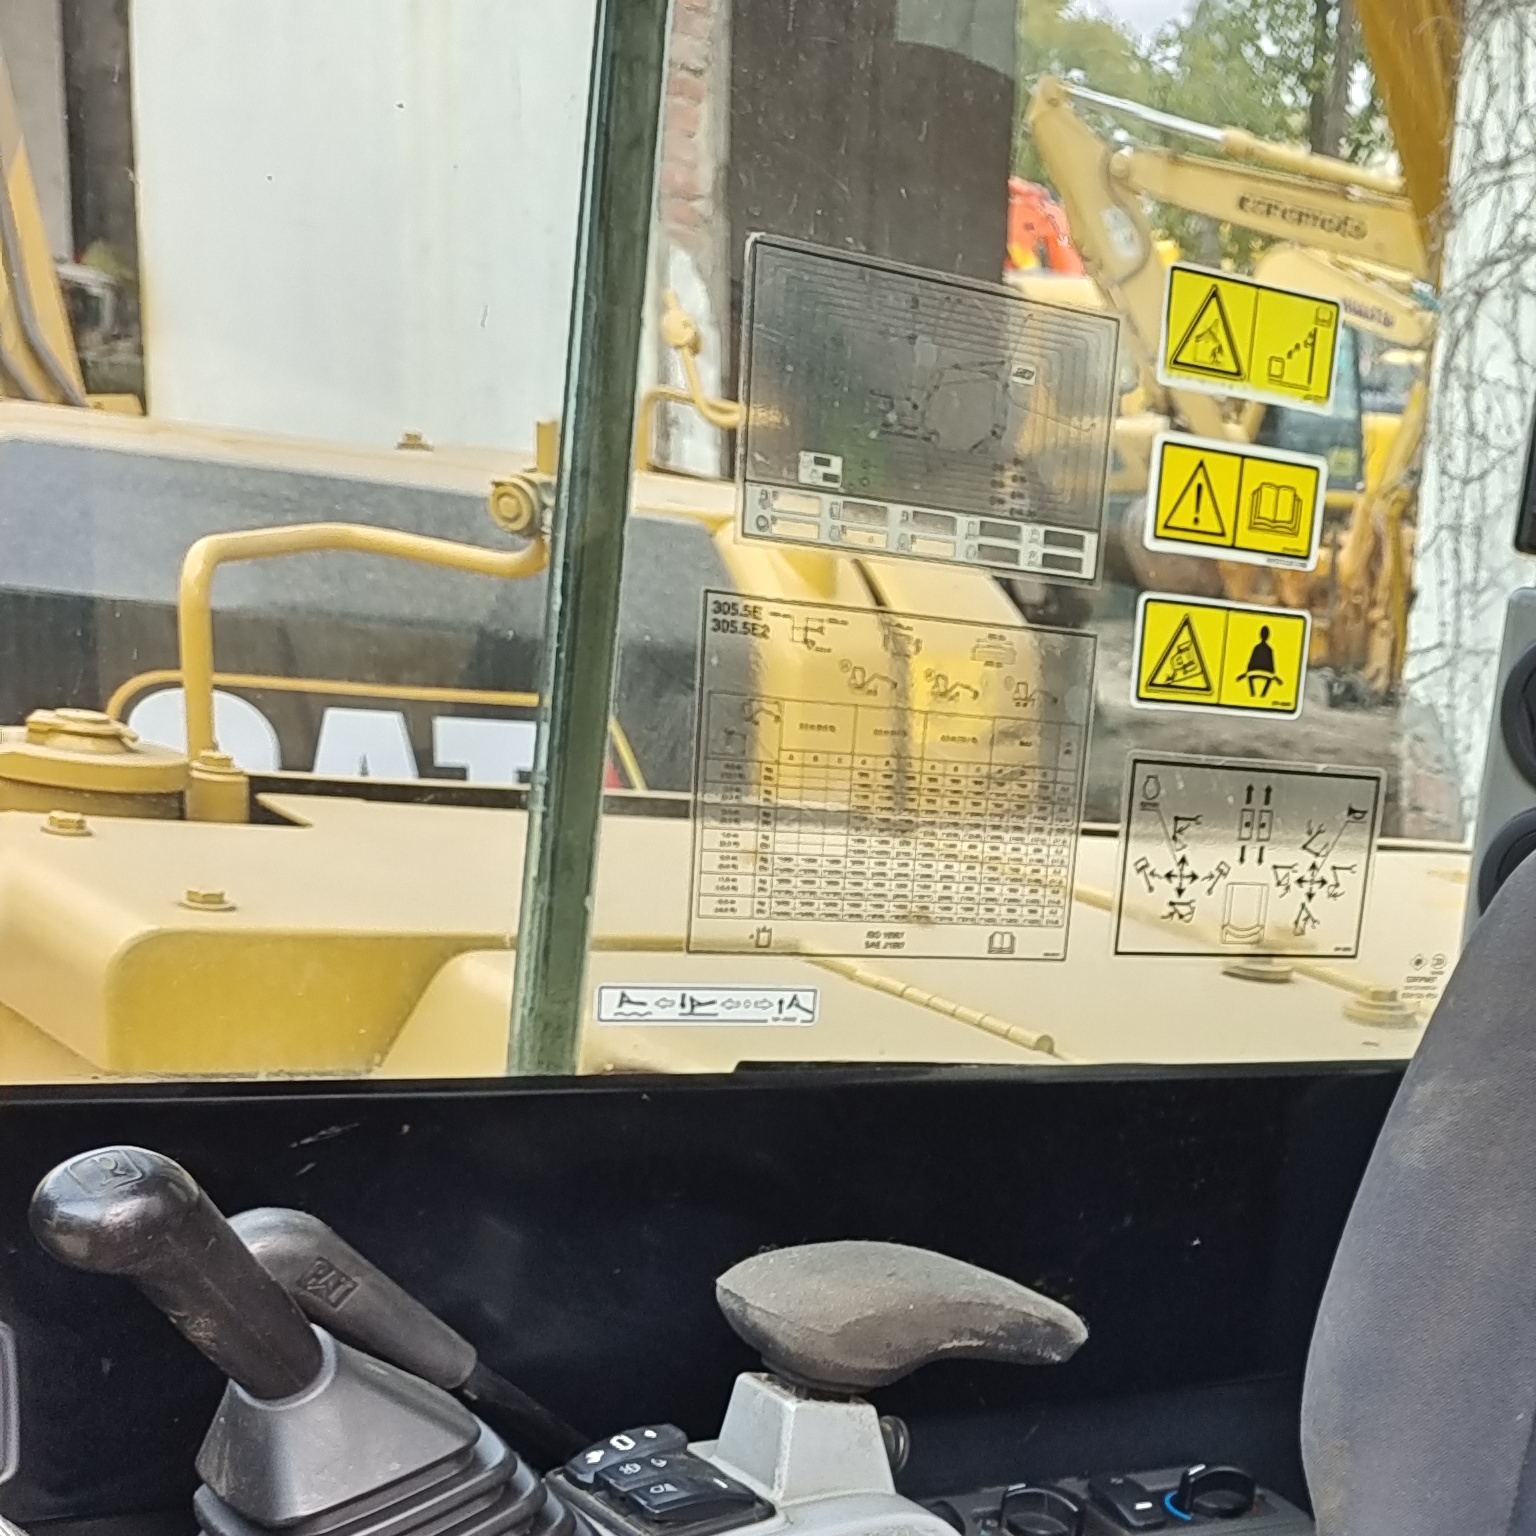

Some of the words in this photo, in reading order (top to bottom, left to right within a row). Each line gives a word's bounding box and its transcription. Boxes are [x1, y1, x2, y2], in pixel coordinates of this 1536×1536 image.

[711, 600, 763, 621] 305.5E
[711, 617, 771, 640] 305.5E2
[304, 1259, 355, 1305] CAT
